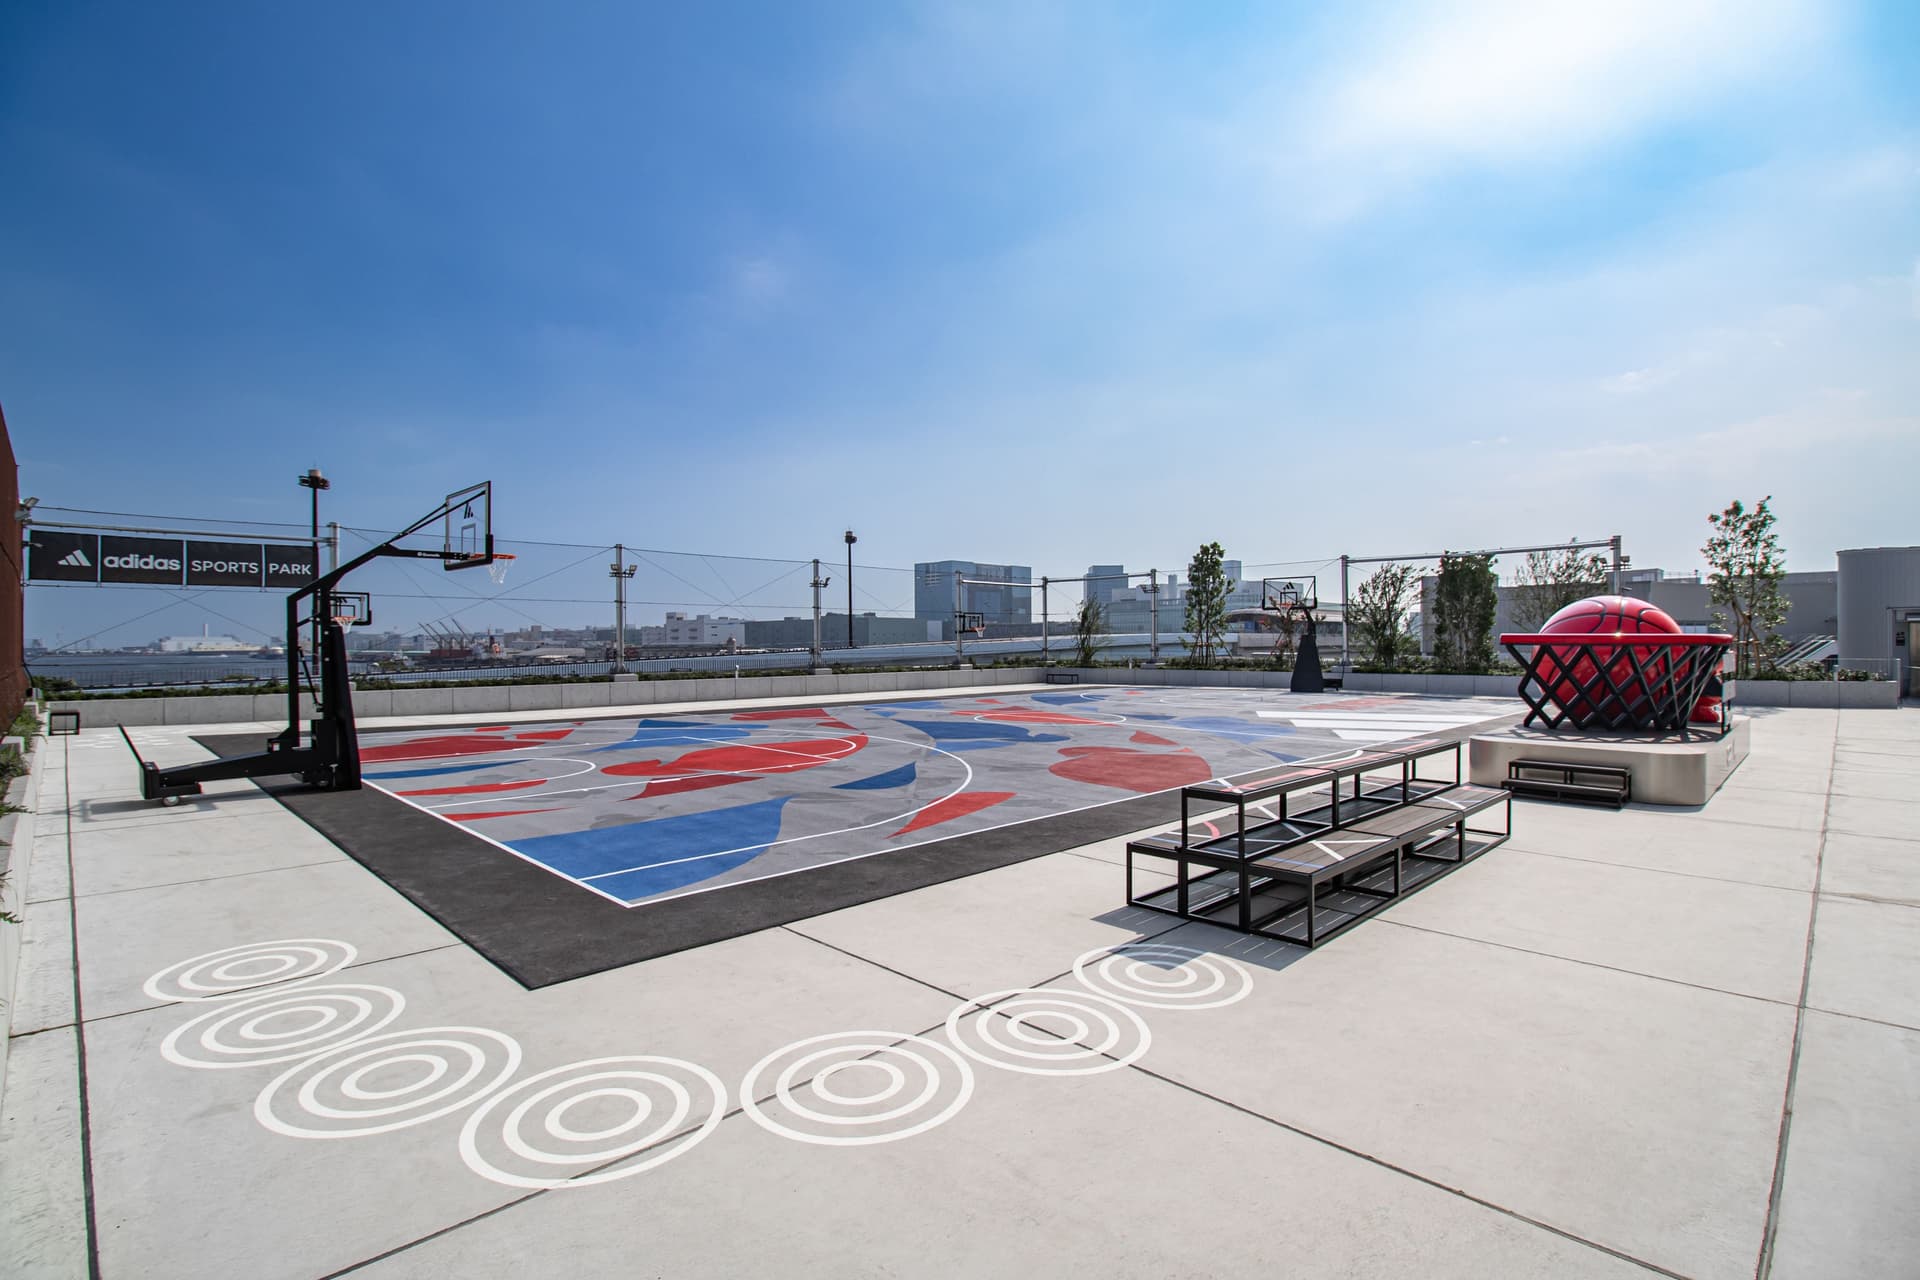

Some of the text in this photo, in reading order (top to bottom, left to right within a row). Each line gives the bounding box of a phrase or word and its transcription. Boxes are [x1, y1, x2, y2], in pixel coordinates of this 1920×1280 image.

[103, 553, 312, 576] adidas SPORTS PARK
